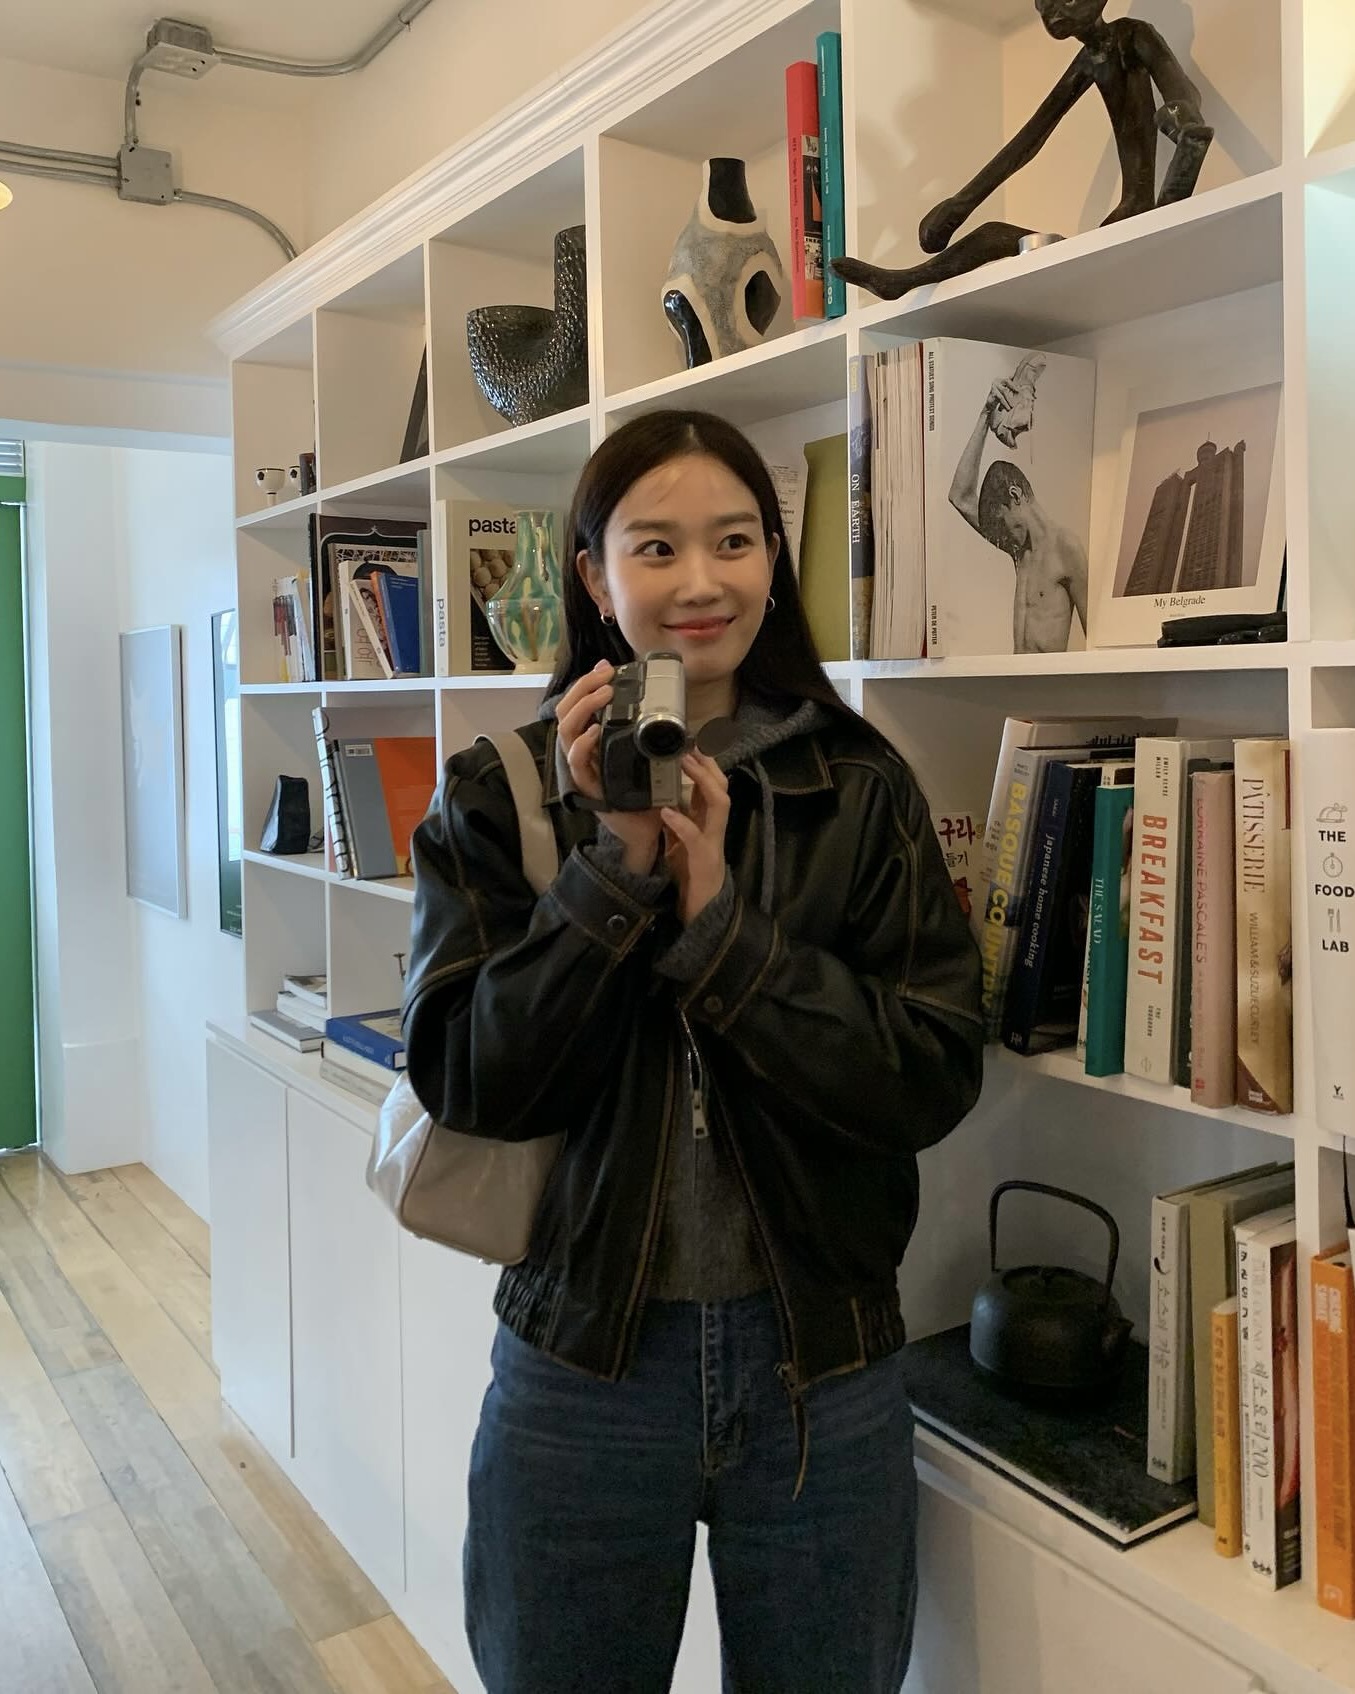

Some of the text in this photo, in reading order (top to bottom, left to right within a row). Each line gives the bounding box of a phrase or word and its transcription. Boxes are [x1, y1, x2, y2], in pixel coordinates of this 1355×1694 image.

[851, 473, 861, 543] ON EARTH
[436, 598, 446, 647] pasta
[1153, 595, 1206, 609] My Belgrade
[996, 782, 1027, 884] BASQUE
[1243, 778, 1270, 892] PÂTISSERIE
[1318, 829, 1347, 843] THE
[1034, 889, 1049, 920] home
[1093, 878, 1104, 943] THE SALAD
[1137, 814, 1168, 985] BREAKFAST
[1314, 883, 1355, 898] FOOD
[1024, 922, 1040, 968] cooking
[1321, 938, 1350, 953] LAB
